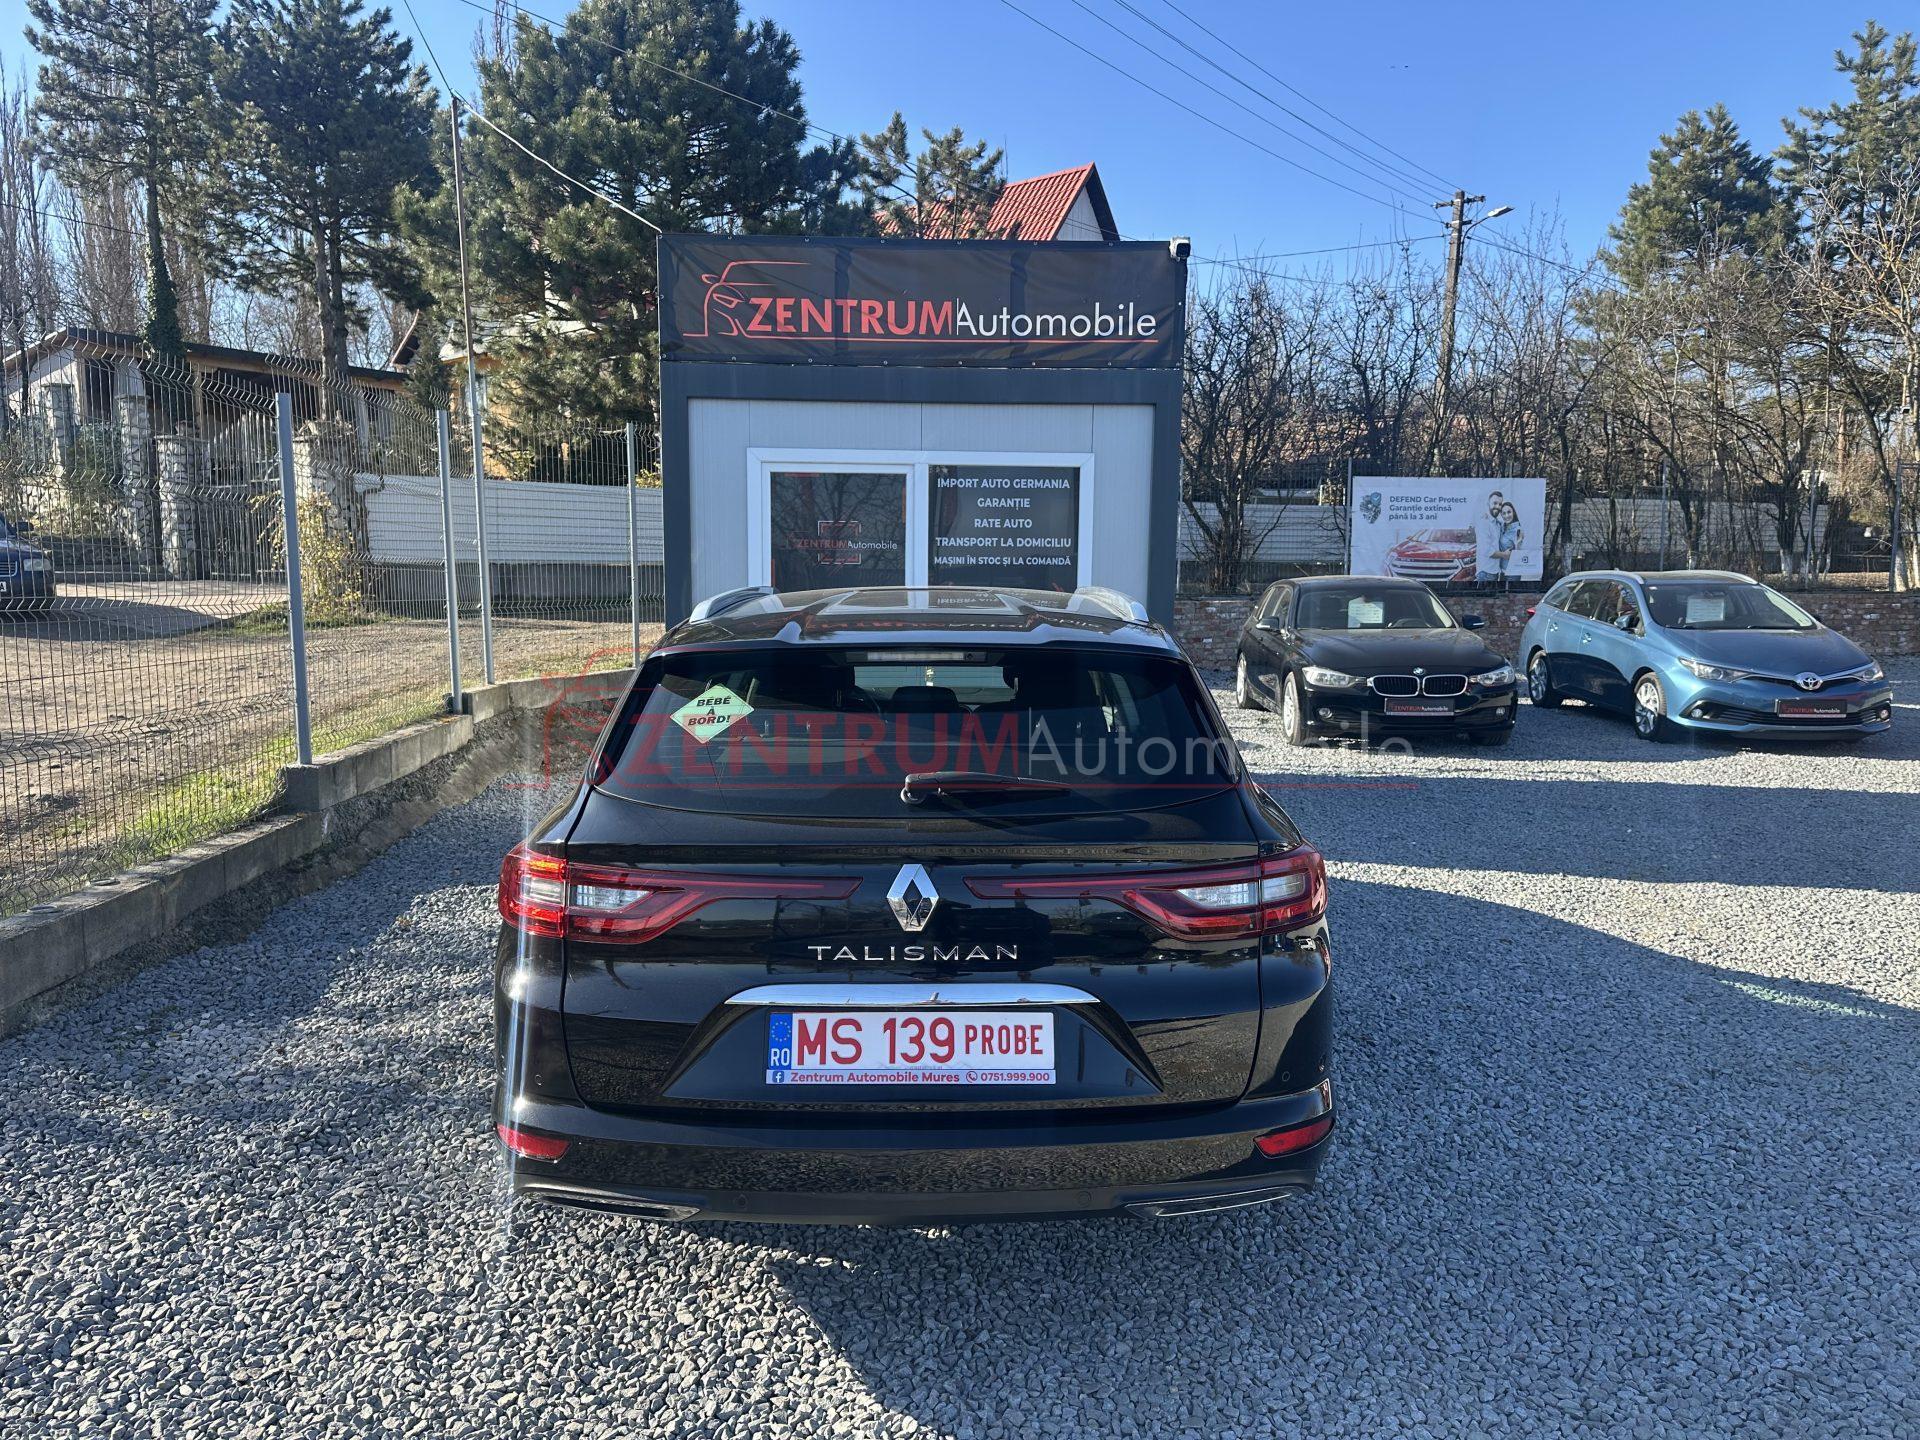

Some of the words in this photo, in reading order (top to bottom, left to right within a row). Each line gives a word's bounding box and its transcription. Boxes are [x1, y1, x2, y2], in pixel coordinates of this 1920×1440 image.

[747, 297, 952, 335] ZENTRUM
[957, 298, 1156, 337] Automobile
[937, 478, 979, 488] IMPORT
[981, 478, 1011, 489] AUTO
[1013, 479, 1071, 489] GERMANIA
[1438, 496, 1467, 504] Protect
[974, 518, 1001, 528] RATE
[1003, 518, 1033, 529] AUTO
[848, 541, 898, 550] Automobile
[935, 537, 998, 547] TRANSPORT
[1001, 538, 1014, 547] LA
[1016, 538, 1072, 548] DOMICILIU
[967, 555, 976, 564] ÎN
[978, 556, 1000, 565] STOC
[1013, 556, 1024, 565] LA
[1026, 555, 1071, 566] COMANDĂ
[687, 715, 731, 726] BORD!
[807, 945, 1018, 961] TALISMAN
[797, 1018, 863, 1066] MS
[883, 1017, 955, 1064] 139
[965, 1024, 1043, 1055] PROBE
[770, 1048, 790, 1066] RO
[791, 1072, 844, 1083] Zentrum
[847, 1071, 918, 1083] Automobile
[922, 1072, 959, 1083] Mures
[981, 1072, 1049, 1082] 0751.999.900
